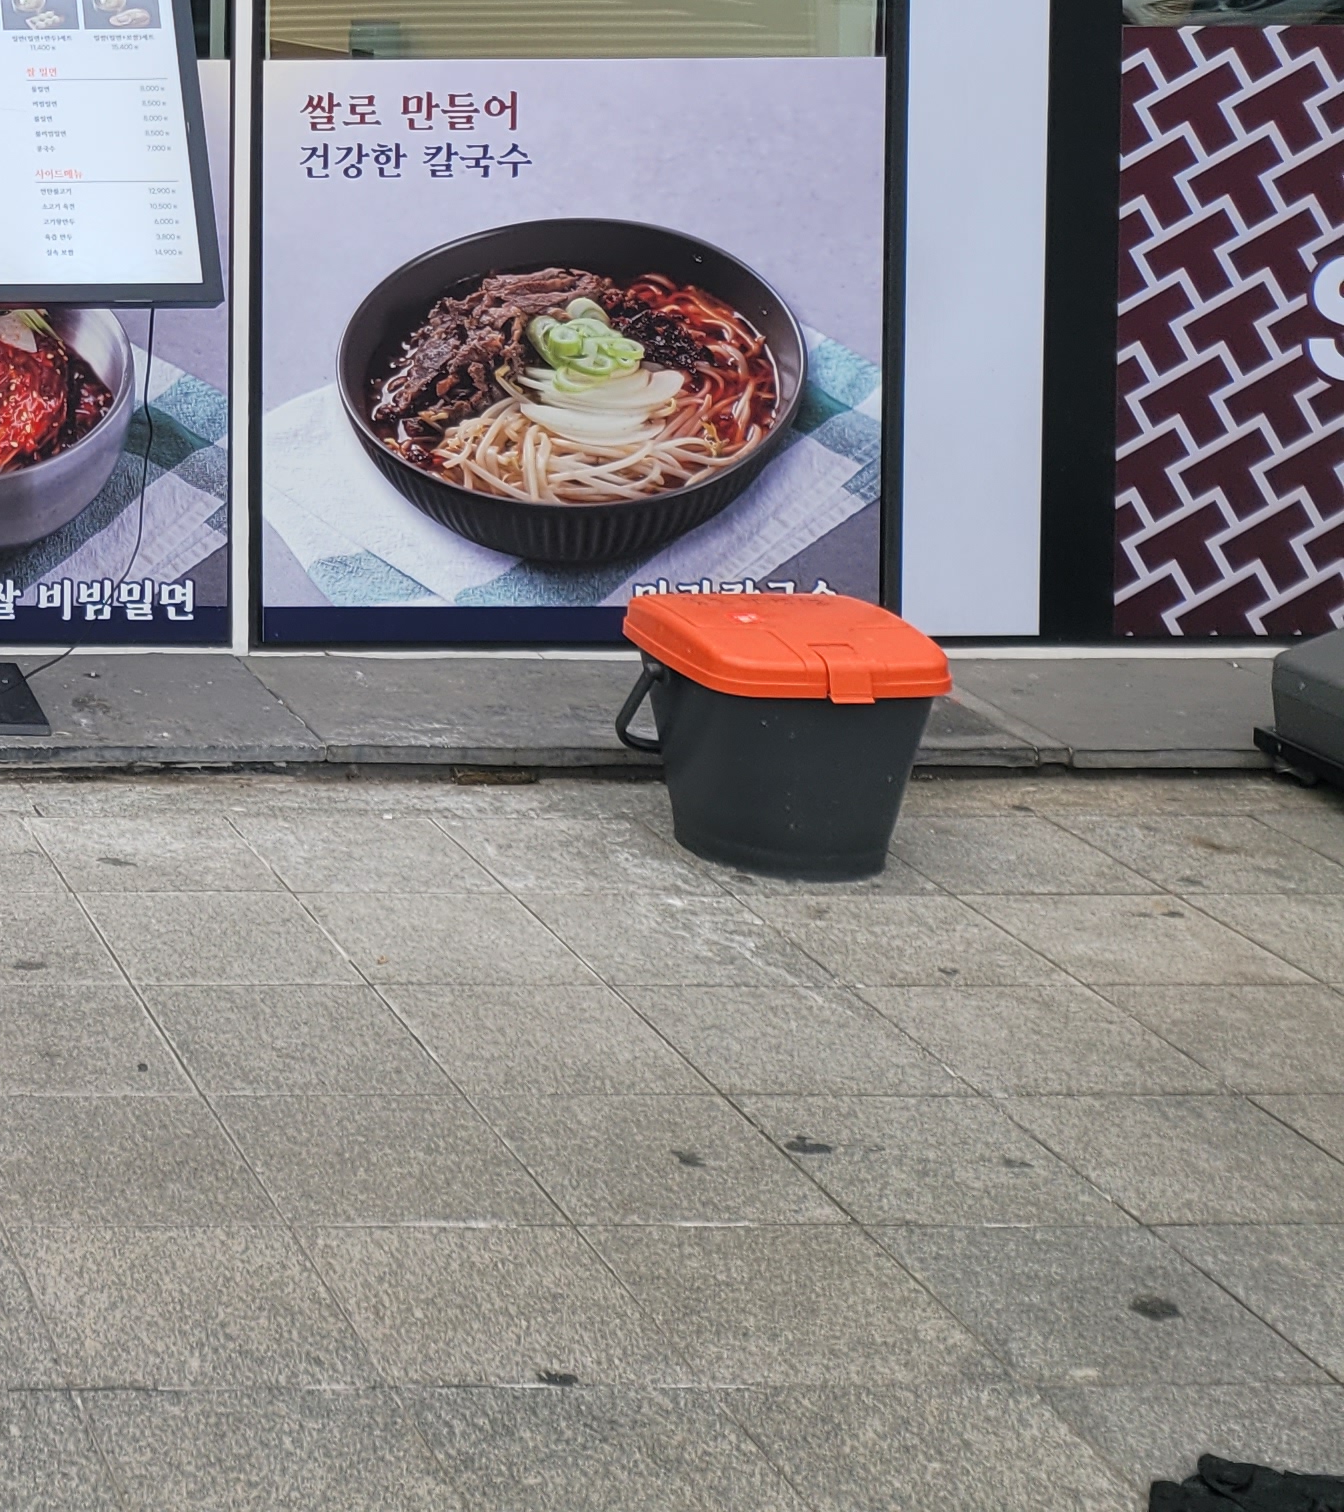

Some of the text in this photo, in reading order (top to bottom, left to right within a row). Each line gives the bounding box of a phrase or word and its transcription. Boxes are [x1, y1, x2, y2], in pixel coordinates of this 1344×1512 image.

[300, 91, 520, 131] 쌀로 만들어
[299, 142, 533, 179] 건강한 칼국수
[36, 577, 196, 622] 비빔밀면
